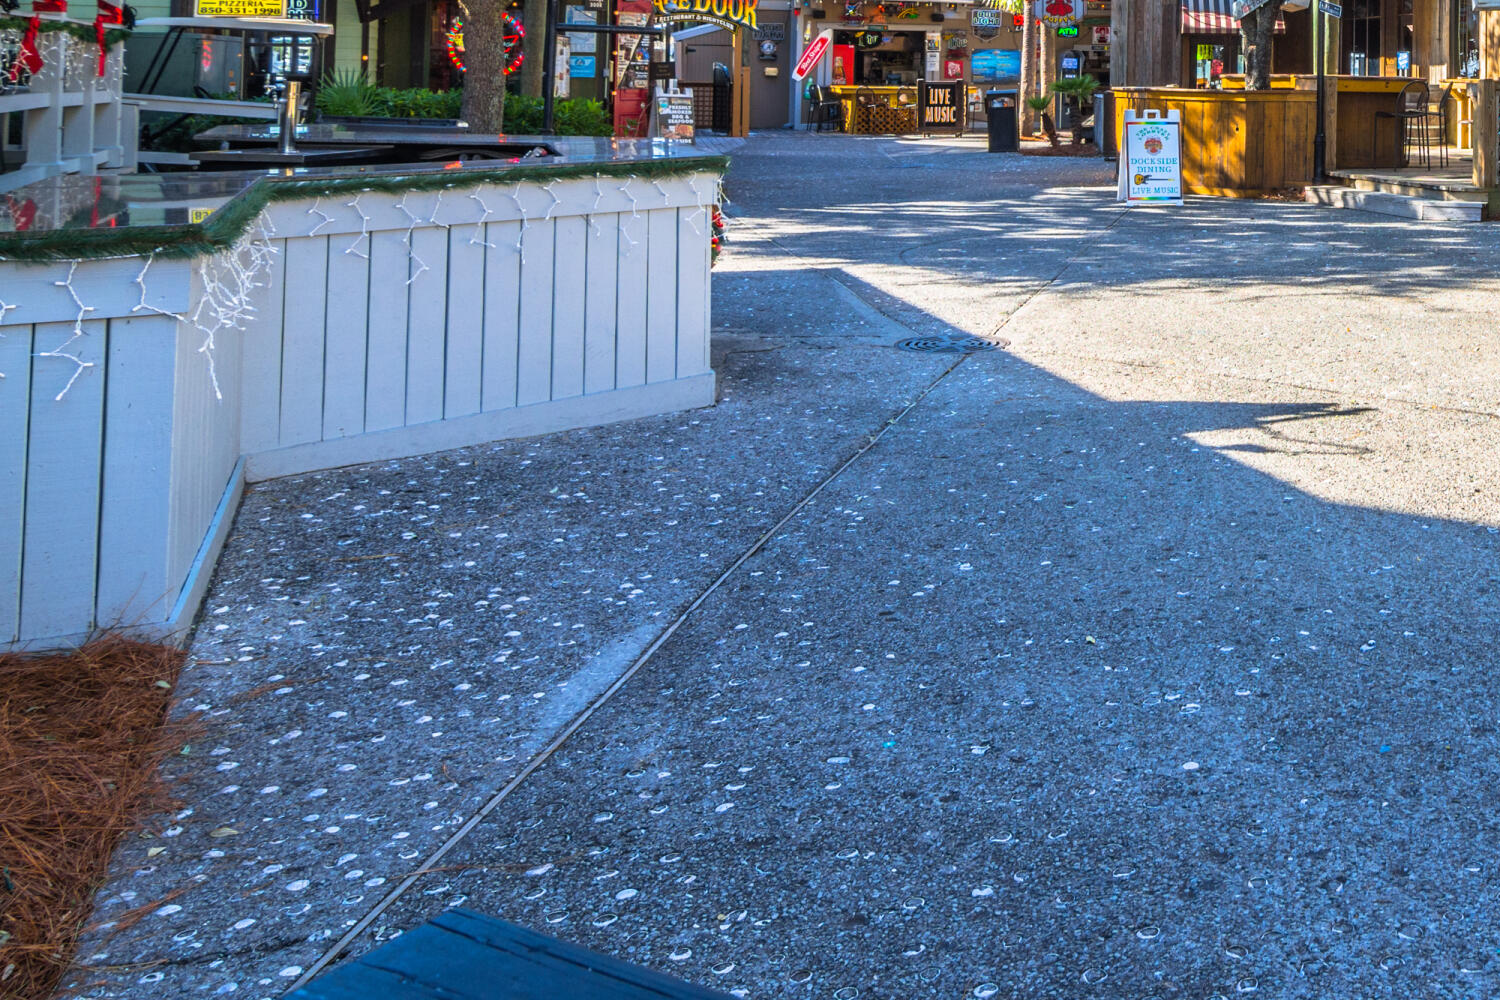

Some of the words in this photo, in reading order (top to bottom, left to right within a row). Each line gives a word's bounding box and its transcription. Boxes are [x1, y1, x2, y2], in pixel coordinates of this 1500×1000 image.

[218, 0, 264, 8] PIZZERIA
[200, 7, 281, 16] 850-351-1998
[1057, 27, 1078, 36] ATM
[929, 88, 951, 105] LIVE
[925, 106, 957, 123] MUSIC
[1132, 187, 1151, 195] LIVE
[1153, 186, 1179, 194] MUSIC
